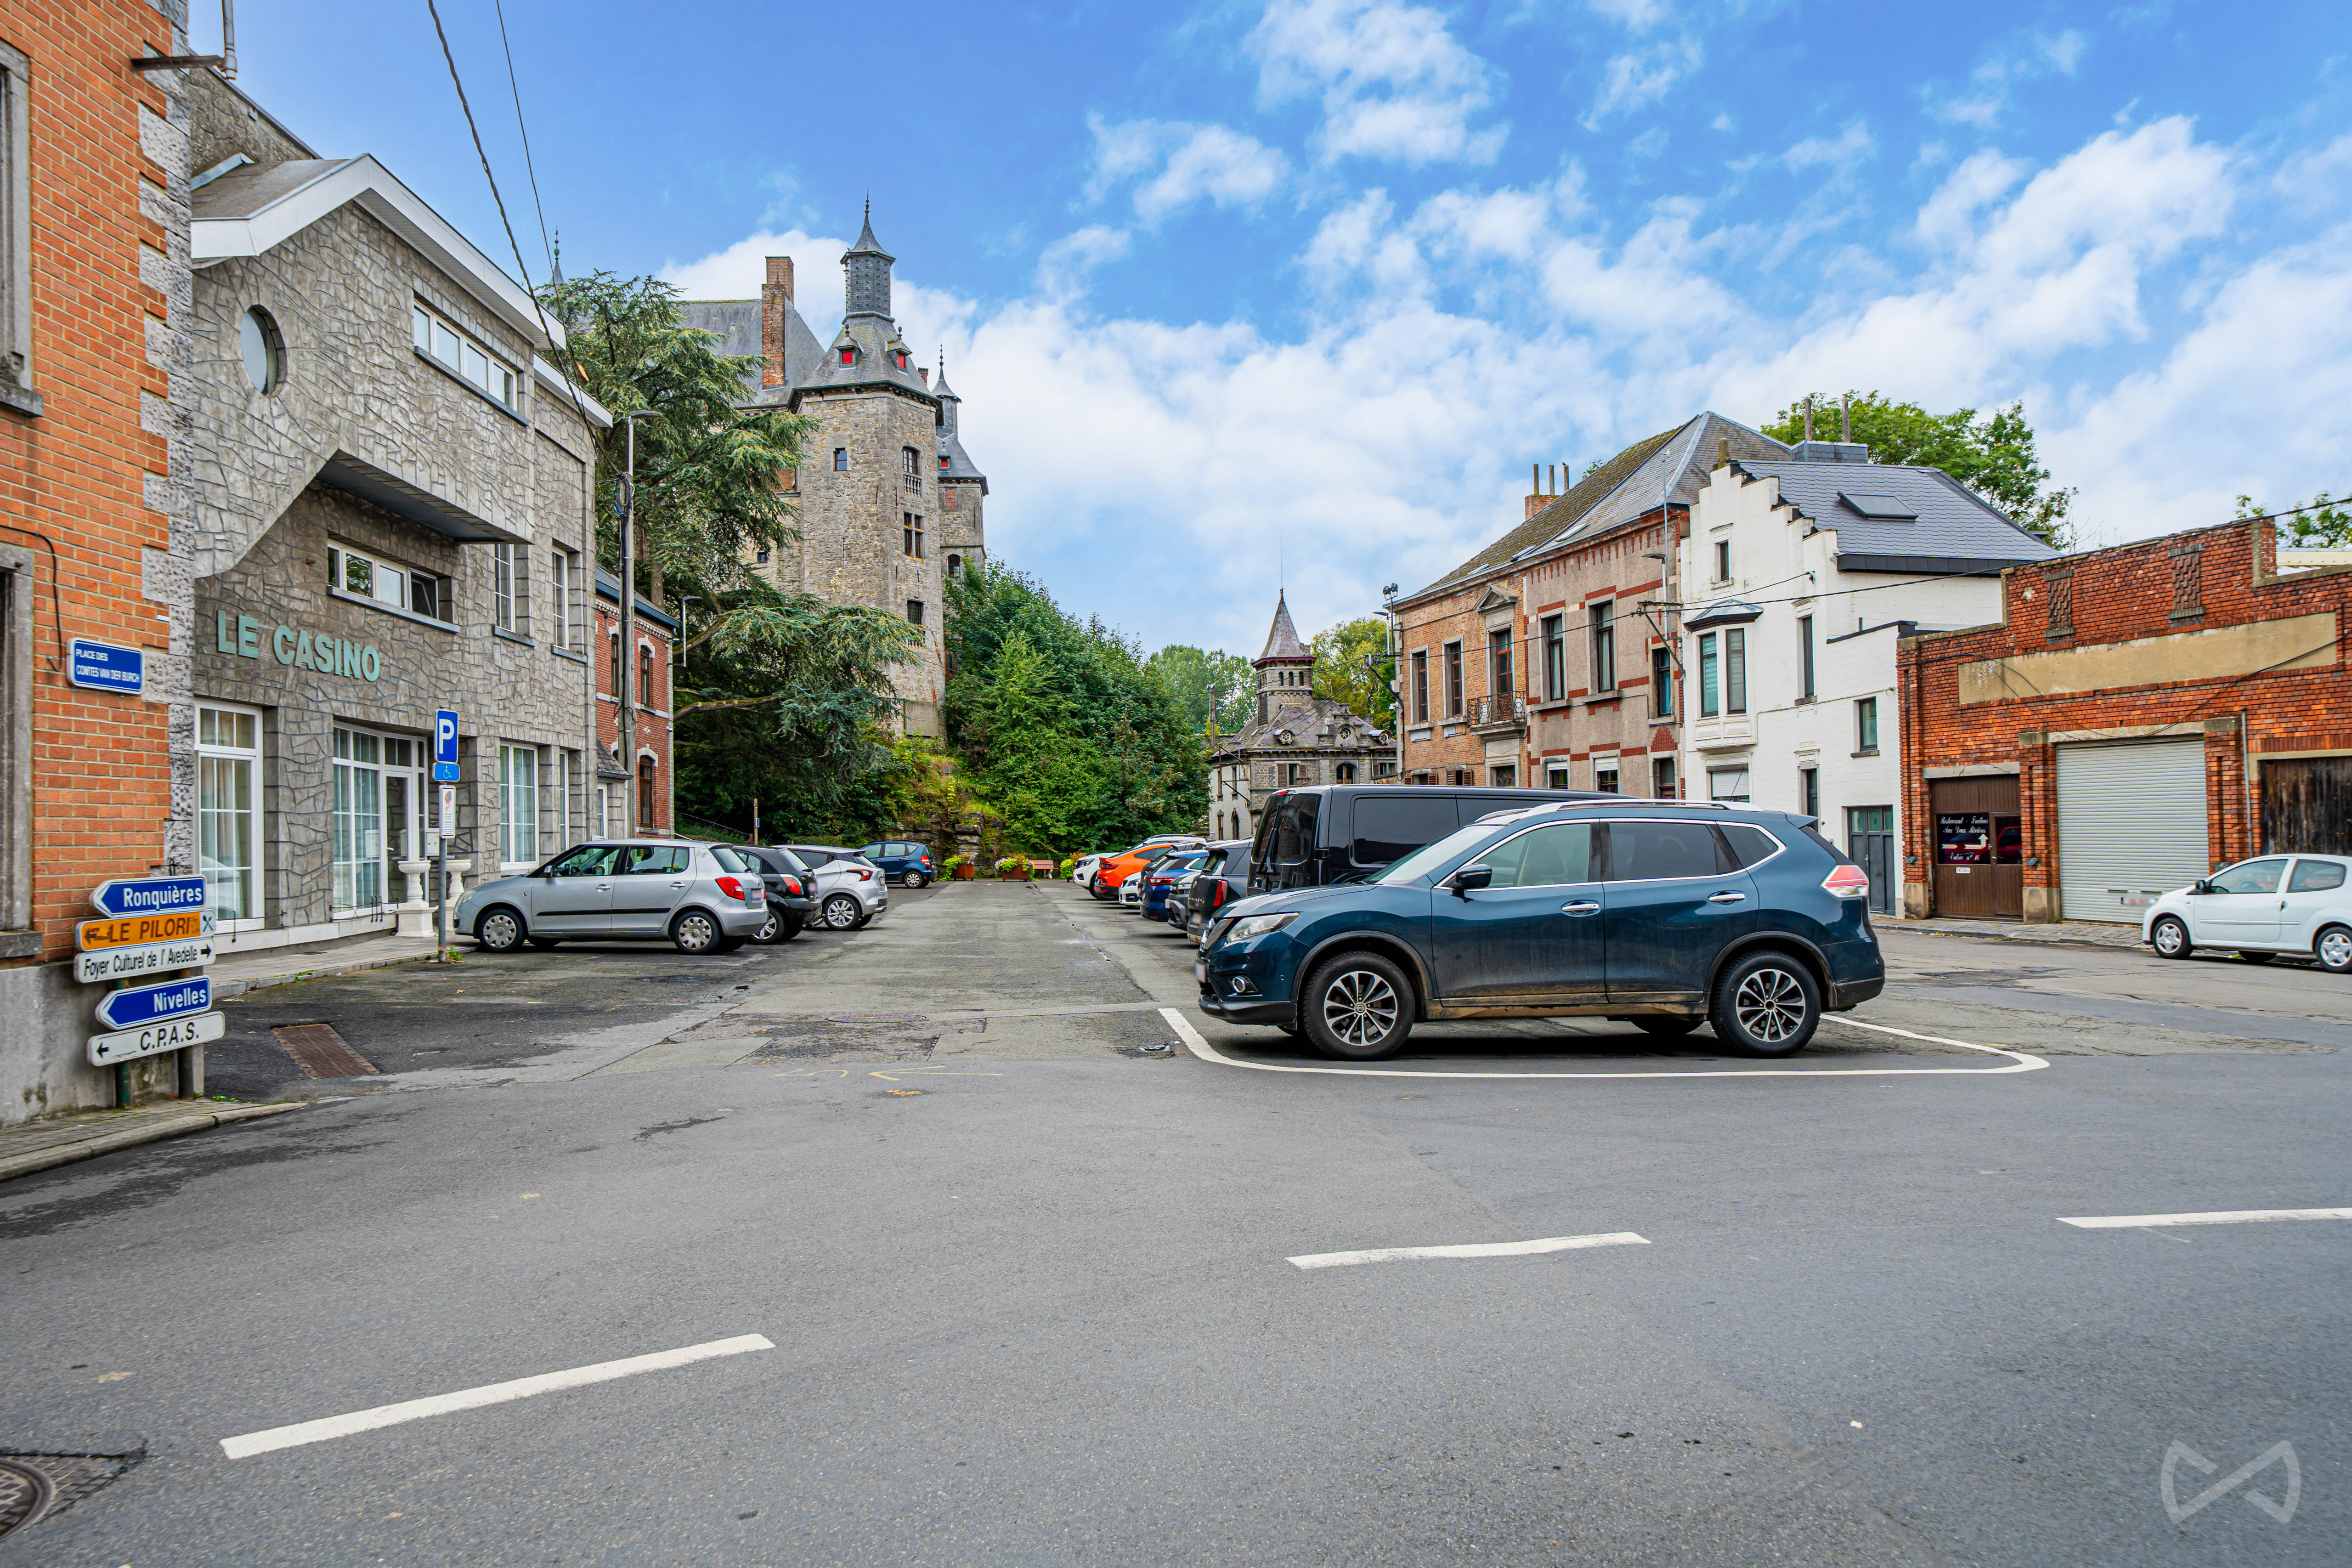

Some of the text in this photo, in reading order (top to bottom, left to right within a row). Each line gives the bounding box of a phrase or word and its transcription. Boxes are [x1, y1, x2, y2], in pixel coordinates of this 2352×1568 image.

[76, 649, 108, 661] PLACE DES
[218, 610, 380, 681] LE CASINO
[76, 665, 140, 683] COMTES VAN DER BURCH
[439, 719, 455, 754] P
[123, 885, 202, 909] Ronquières
[109, 917, 190, 943] LE PILORI
[84, 958, 110, 979] Foyer
[113, 951, 145, 972] Culturel
[147, 951, 157, 967] de
[167, 945, 198, 964] Avedelle
[153, 987, 207, 1012] Nivelles
[140, 1022, 199, 1051] C.P.A.S.
